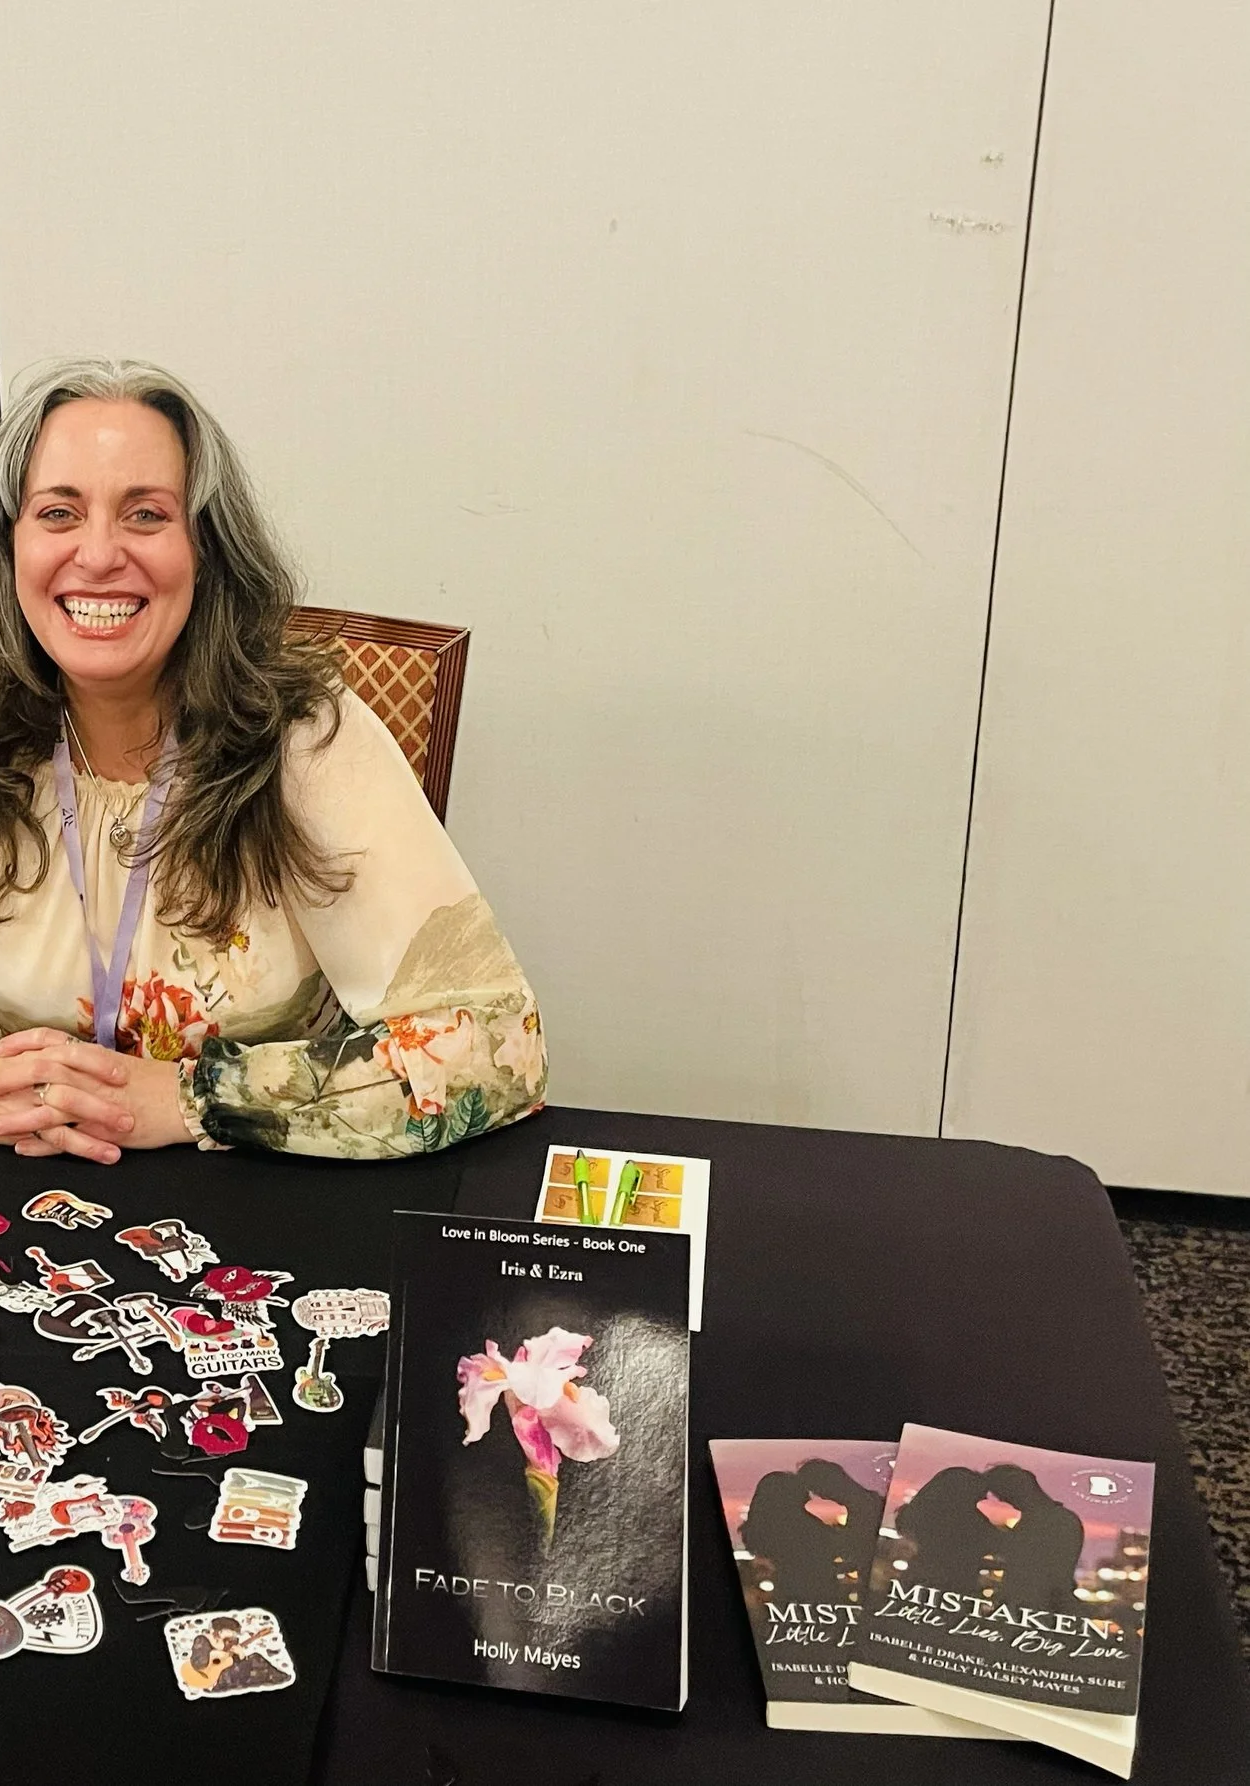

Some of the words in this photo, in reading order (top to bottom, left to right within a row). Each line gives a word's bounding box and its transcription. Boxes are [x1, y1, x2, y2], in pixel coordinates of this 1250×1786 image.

[441, 1226, 471, 1240] Love
[474, 1228, 486, 1240] in
[489, 1230, 530, 1245] Bloom
[532, 1233, 570, 1248] Series
[582, 1238, 615, 1251] Book
[618, 1241, 646, 1254] One
[501, 1260, 526, 1277] Iris
[529, 1263, 543, 1279] &
[548, 1264, 583, 1282] Ezra
[189, 1354, 217, 1362] HAVE
[220, 1352, 243, 1360] TOO
[246, 1349, 277, 1357] MANY
[191, 1356, 281, 1375] GUITARS
[415, 1568, 490, 1598] FADE
[497, 1581, 536, 1603] TO
[546, 1583, 646, 1617] BLACK
[72, 1598, 91, 1641] SHVILLE
[764, 1602, 863, 1625] MIST
[887, 1579, 1124, 1642] MISTAKEN:
[765, 1624, 831, 1646] Little
[874, 1600, 947, 1626] Little
[1011, 1630, 1066, 1657] Big
[1069, 1639, 1131, 1659] Love
[473, 1638, 519, 1665] Holly
[524, 1645, 581, 1671] Mayes
[771, 1662, 834, 1673] ISABELLE
[869, 1632, 934, 1654] ISABELLE
[992, 1661, 1085, 1684] ALEXANDRIA
[1087, 1677, 1127, 1689] SURE
[908, 1653, 917, 1662] &
[921, 1656, 969, 1674] HOLLY
[972, 1667, 1030, 1685] HALSEY
[1031, 1679, 1080, 1695] MAYES
